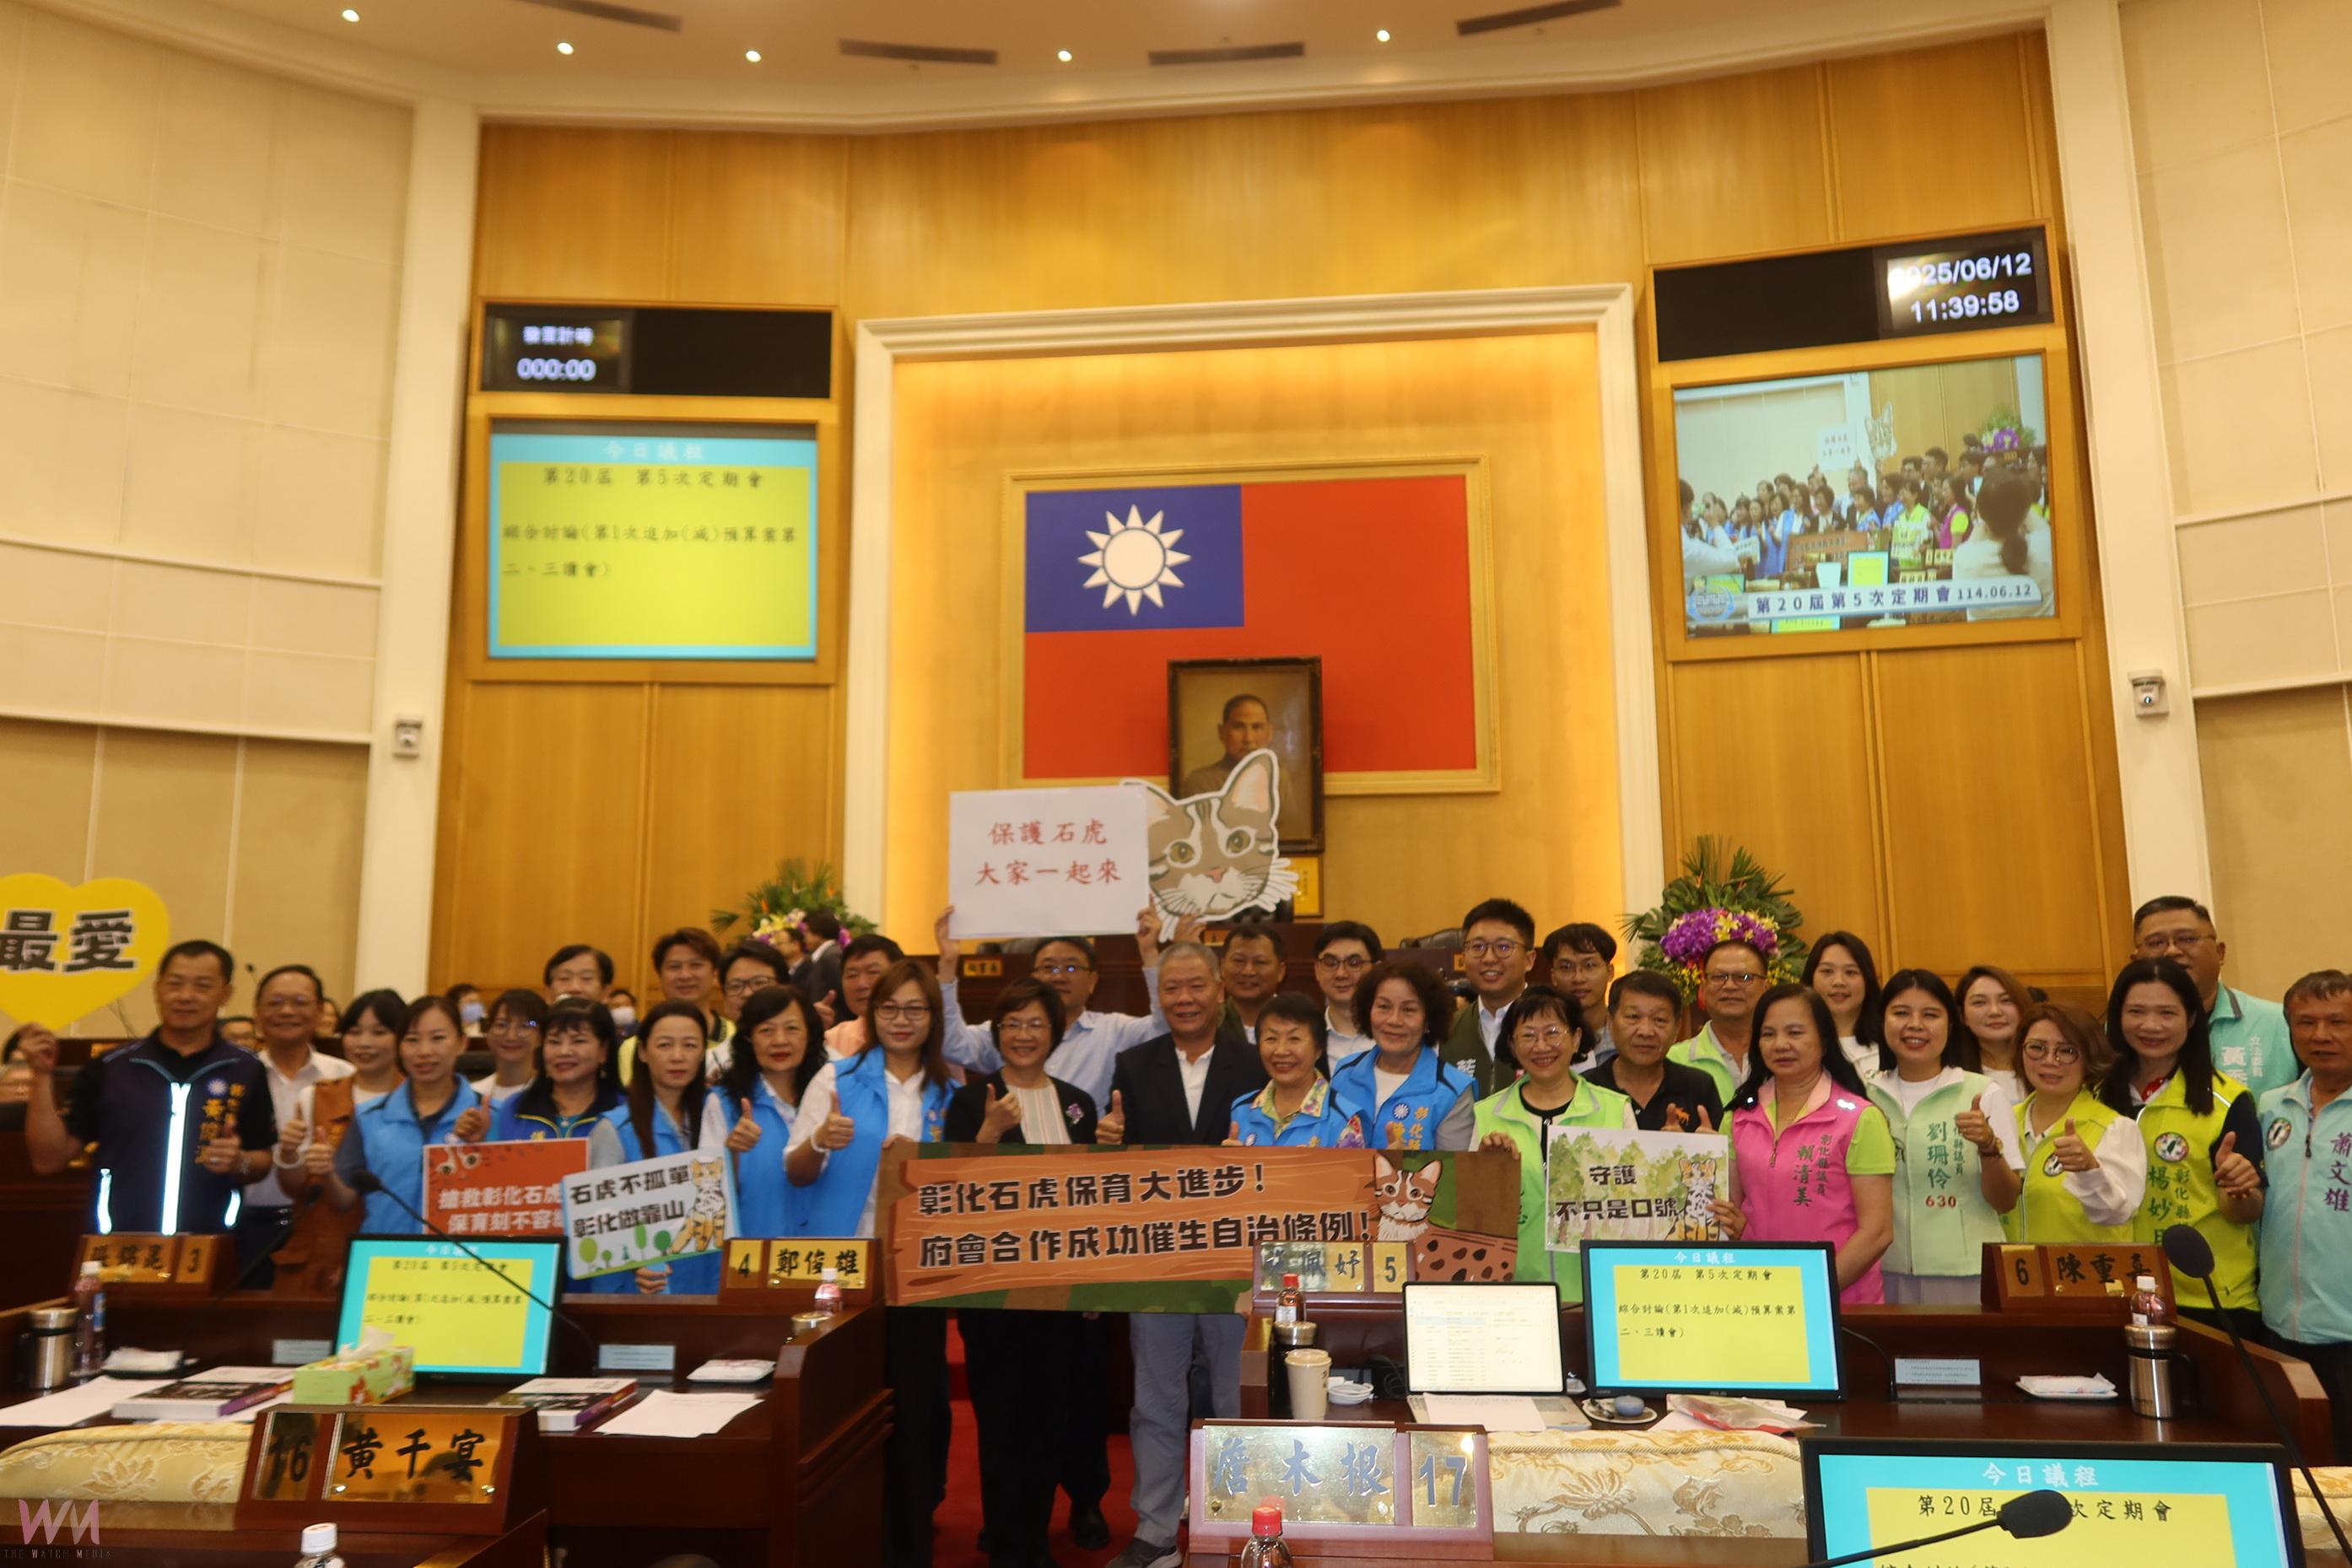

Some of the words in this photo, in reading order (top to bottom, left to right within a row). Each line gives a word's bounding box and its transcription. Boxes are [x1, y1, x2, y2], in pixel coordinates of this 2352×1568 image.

[1886, 252, 2032, 285] 025/06/12
[1910, 290, 2020, 324] 11:39:58
[516, 358, 596, 381] 000:00
[1756, 585, 1951, 614] 第20屆第5次定期會
[1956, 584, 2031, 601] 114.06.12
[988, 818, 1108, 845] 保護石虎
[974, 859, 1121, 886] 大家一起來
[0, 909, 136, 973] 最愛
[1926, 1121, 1951, 1189] 劉珊伶
[570, 1164, 690, 1205] 石虎不孤單
[1589, 1165, 1637, 1185] 守護
[2323, 1132, 2352, 1212] 蕭文雄
[1556, 1199, 1679, 1221] 不只是口號
[1925, 1195, 1957, 1209] 630
[574, 1200, 685, 1238] 彰化做靠山
[737, 1253, 750, 1278] 4
[776, 1248, 859, 1276] 鄭俊雄
[1385, 1256, 1396, 1283] 5
[1674, 1250, 1735, 1264] 今日議程
[1640, 1268, 1681, 1280] 第20屆
[1694, 1268, 1772, 1281] 第5次定期會
[2015, 1258, 2029, 1286] 6
[271, 1438, 310, 1483] 16
[1212, 1436, 1390, 1497] 詹木根
[1419, 1454, 1467, 1507] 17
[1982, 1463, 2099, 1487] 今日議程
